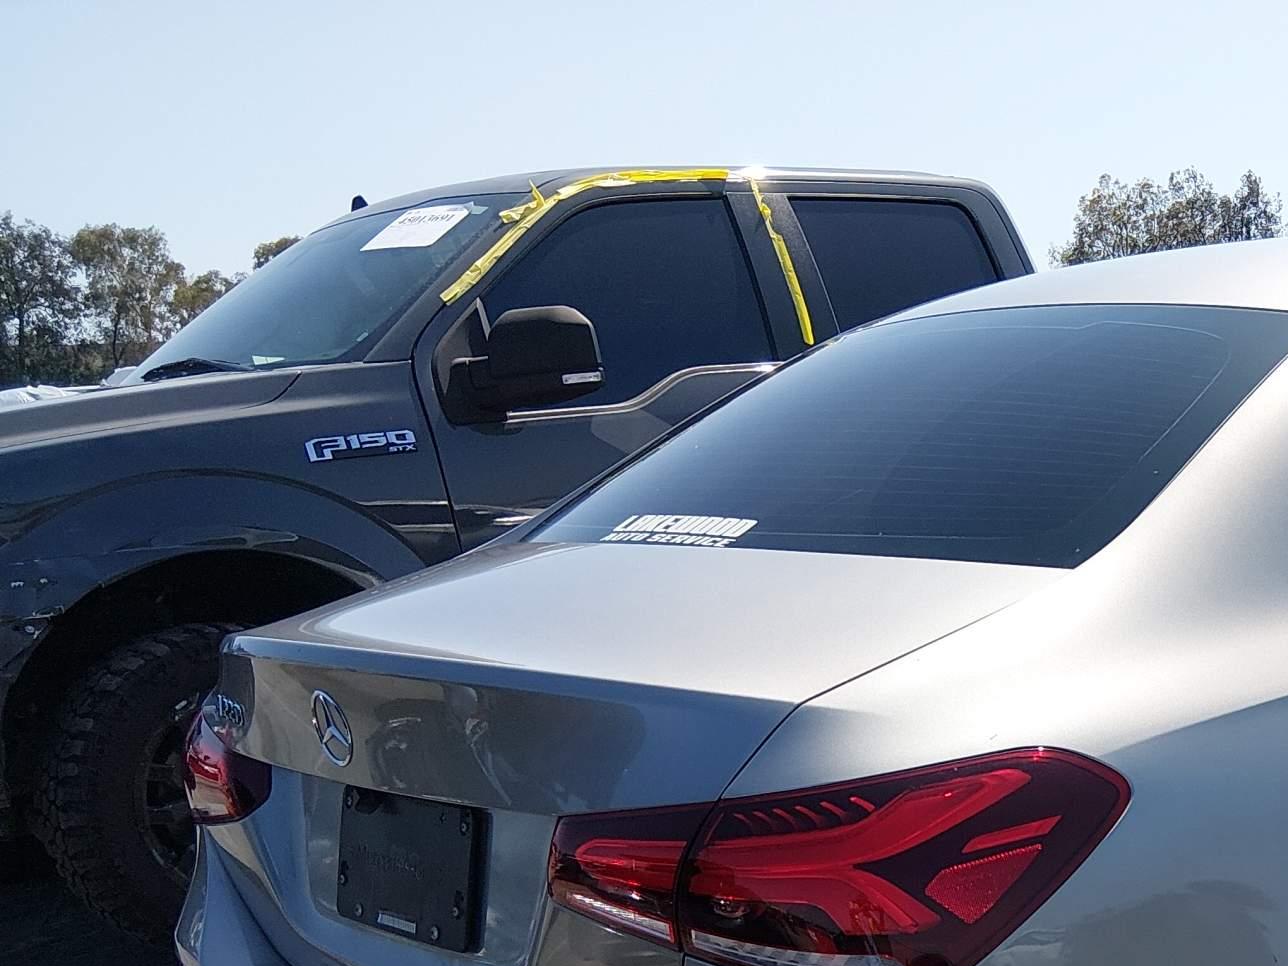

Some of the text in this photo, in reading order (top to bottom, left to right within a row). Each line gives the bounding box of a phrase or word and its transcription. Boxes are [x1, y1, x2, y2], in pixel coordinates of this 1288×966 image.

[388, 444, 417, 452] STX
[613, 514, 758, 538] LAKEWOOD
[599, 532, 737, 548] AUTO SERVICE
